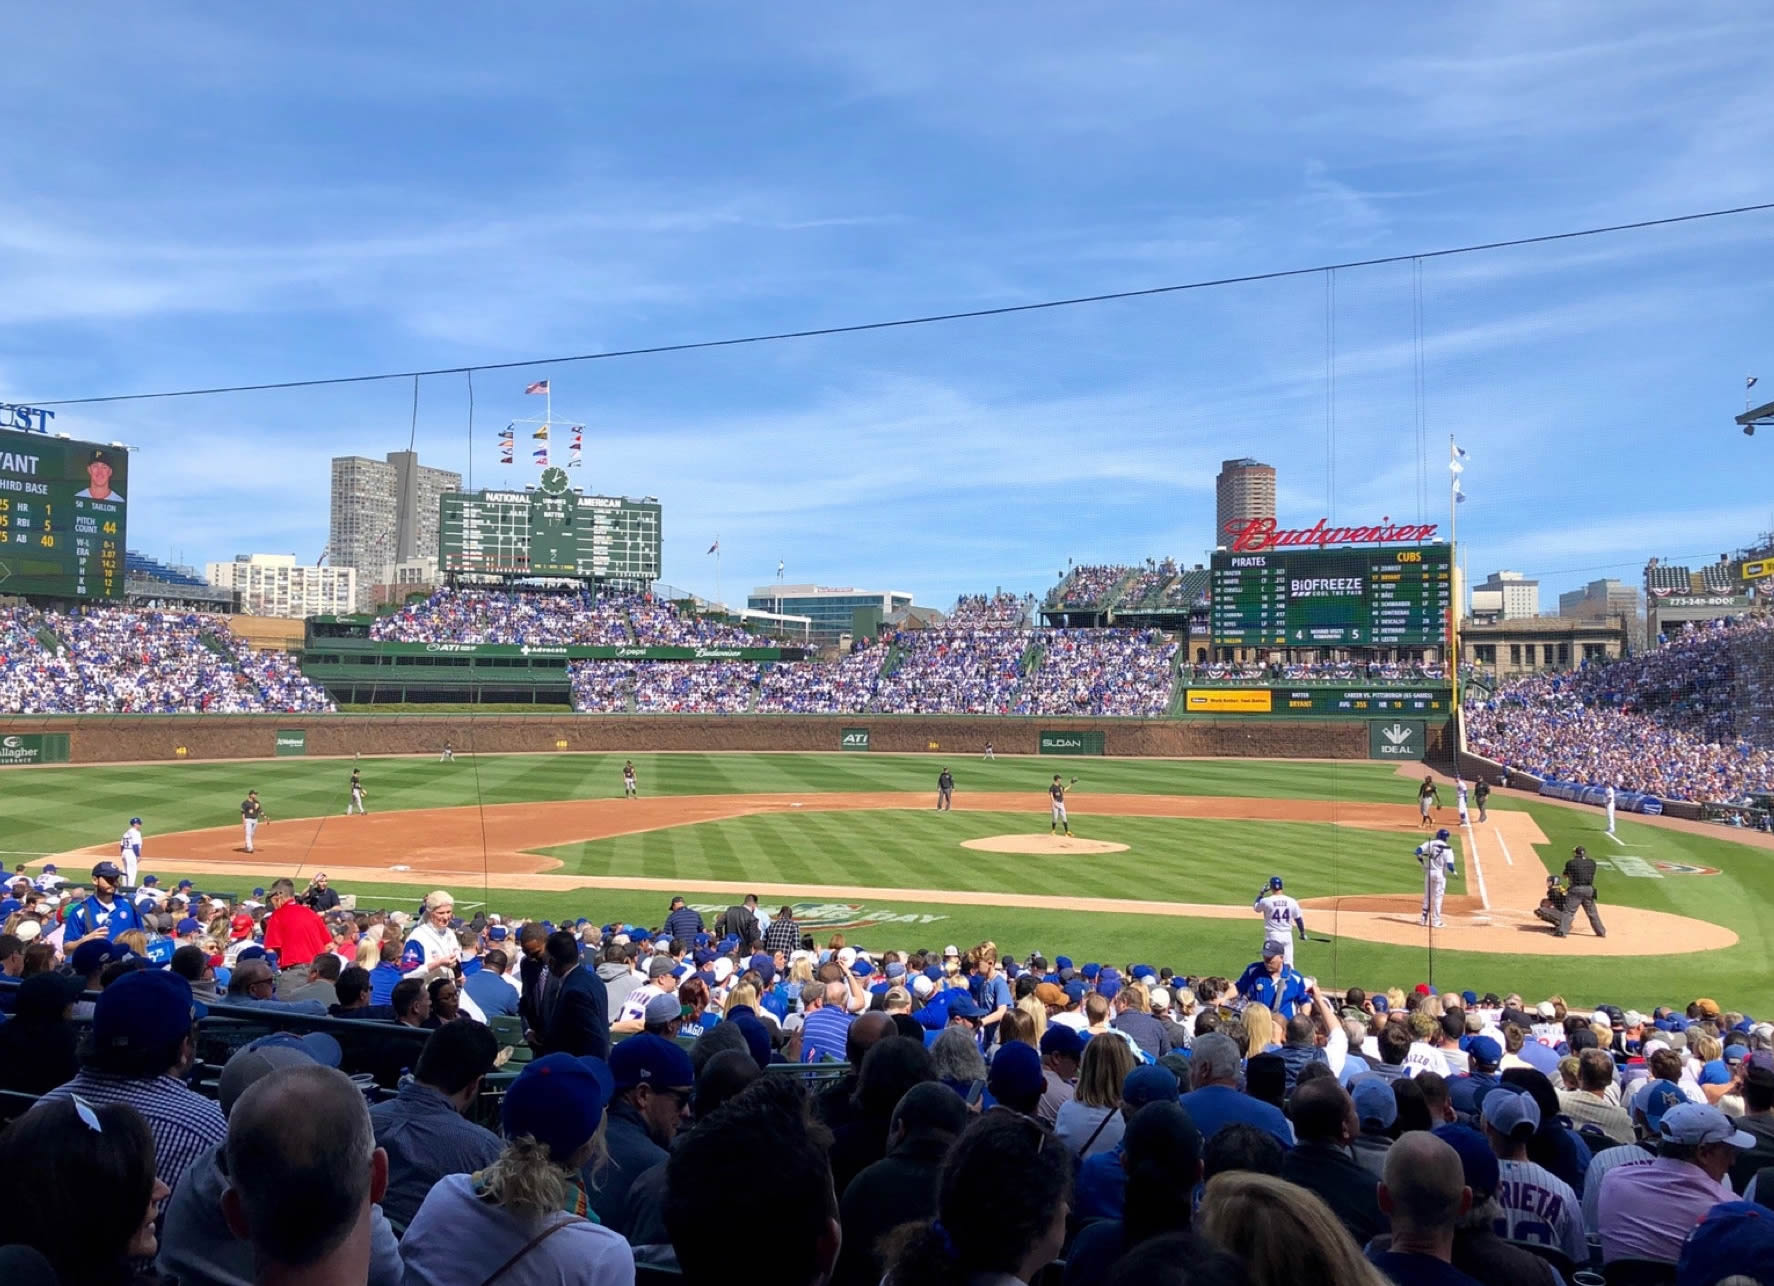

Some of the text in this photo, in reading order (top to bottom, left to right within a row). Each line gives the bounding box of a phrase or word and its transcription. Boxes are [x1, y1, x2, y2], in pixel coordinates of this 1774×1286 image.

[0, 451, 39, 475] ANT
[25, 482, 48, 495] BASE
[486, 492, 531, 503] NATIONAL
[577, 497, 621, 508] AMERICAN
[17, 503, 29, 512] HR
[45, 504, 51, 516] 1
[91, 502, 117, 512] TAILLON
[17, 517, 30, 528] RBI
[44, 519, 51, 532] 5
[76, 516, 96, 525] PITCH
[75, 524, 98, 534] COUNT
[103, 520, 117, 535] 44
[1224, 516, 1438, 551] Budweiser
[16, 534, 27, 543] AB
[41, 535, 54, 548] 40
[76, 547, 90, 556] ERA
[1397, 552, 1421, 562] CUBS
[1231, 557, 1266, 567] PIRATES
[1295, 629, 1303, 640] 4
[1351, 629, 1359, 640] 5
[625, 648, 646, 656] pepsi
[694, 647, 741, 658] Budweiser
[1289, 700, 1312, 708] BRYANT
[842, 734, 869, 743] ATI
[1042, 739, 1081, 747] SLOAN
[0, 746, 38, 758] llagher
[1381, 745, 1414, 753] IDEAL
[1271, 908, 1290, 923] 44
[1501, 1180, 1563, 1224] RIETA
